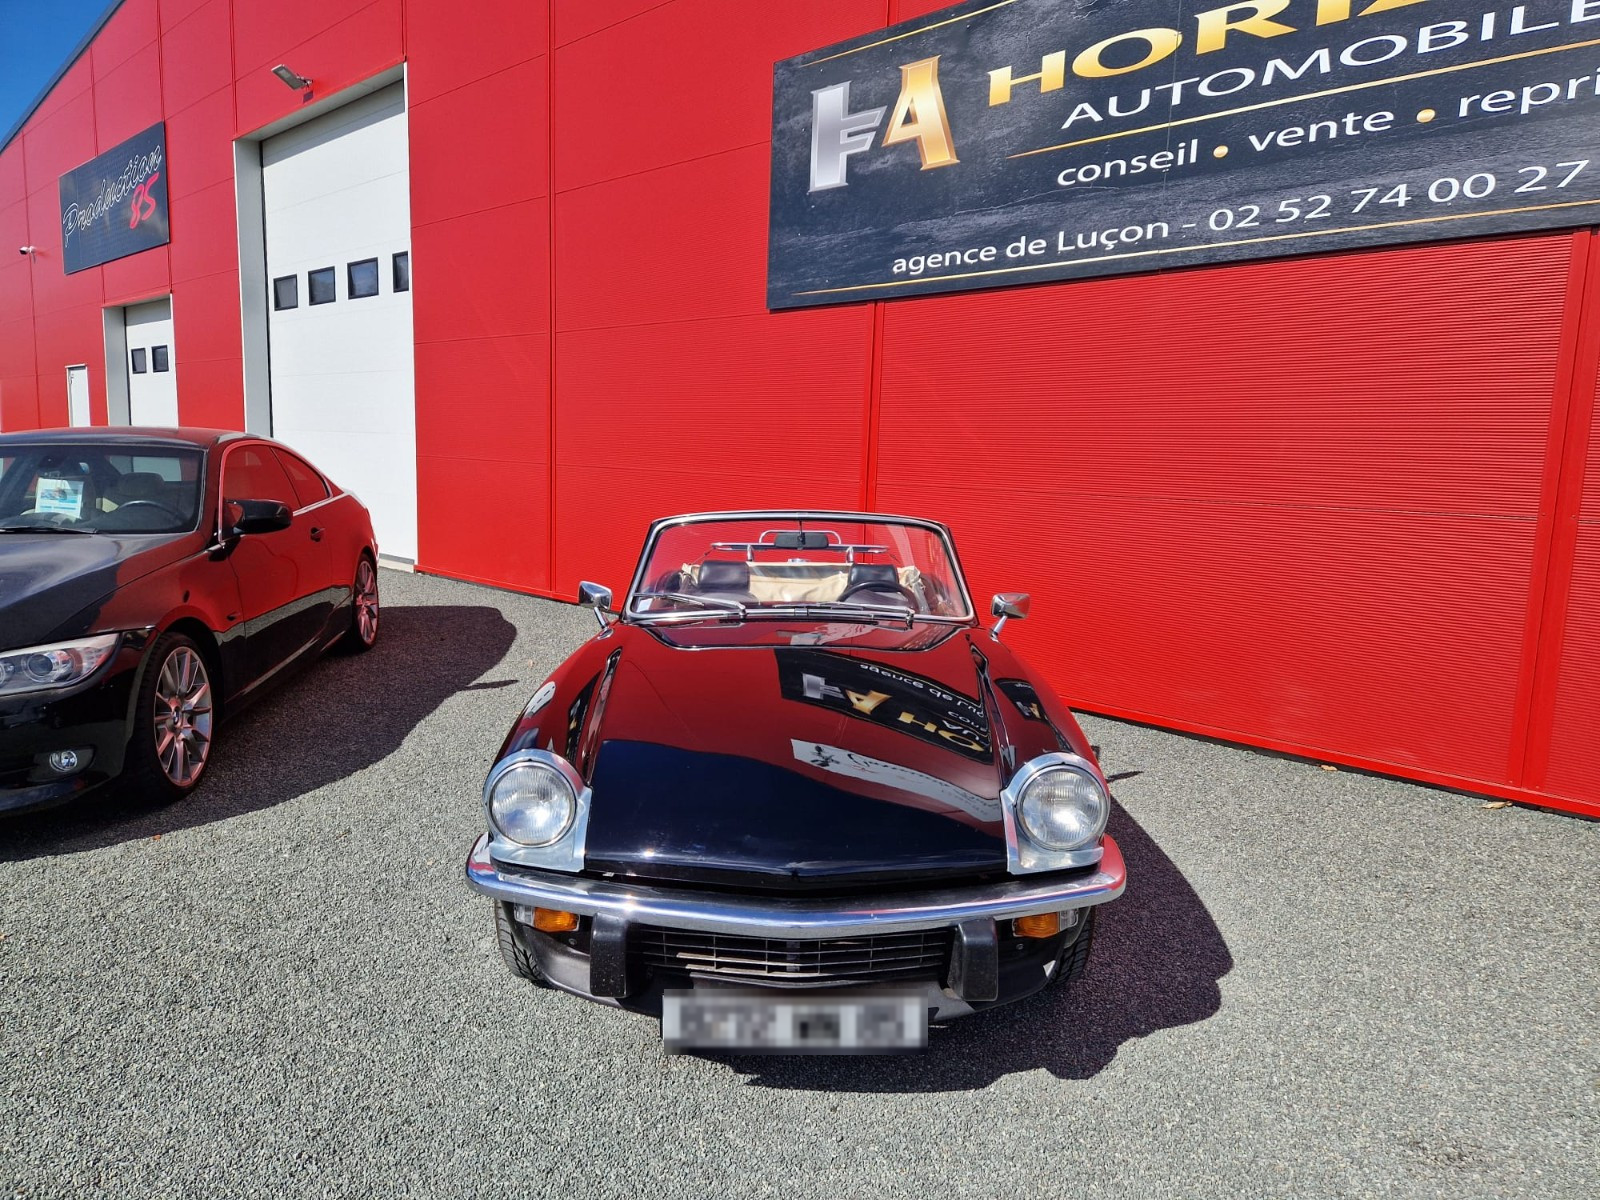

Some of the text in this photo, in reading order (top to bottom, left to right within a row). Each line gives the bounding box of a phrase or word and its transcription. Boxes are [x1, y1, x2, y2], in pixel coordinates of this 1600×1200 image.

[1061, 0, 1600, 129] AUTOMOBILE
[63, 145, 162, 247] Production
[1057, 139, 1198, 186] conseil
[1249, 111, 1394, 152] vente
[130, 172, 159, 229] 85
[892, 244, 997, 275] agence
[1005, 236, 1047, 258] de
[1057, 220, 1169, 251] Luçon
[1208, 205, 1260, 231] 02
[1275, 195, 1332, 222] 52
[1350, 184, 1412, 214] 74
[1427, 173, 1496, 203] 00
[1514, 160, 1590, 193] 27
